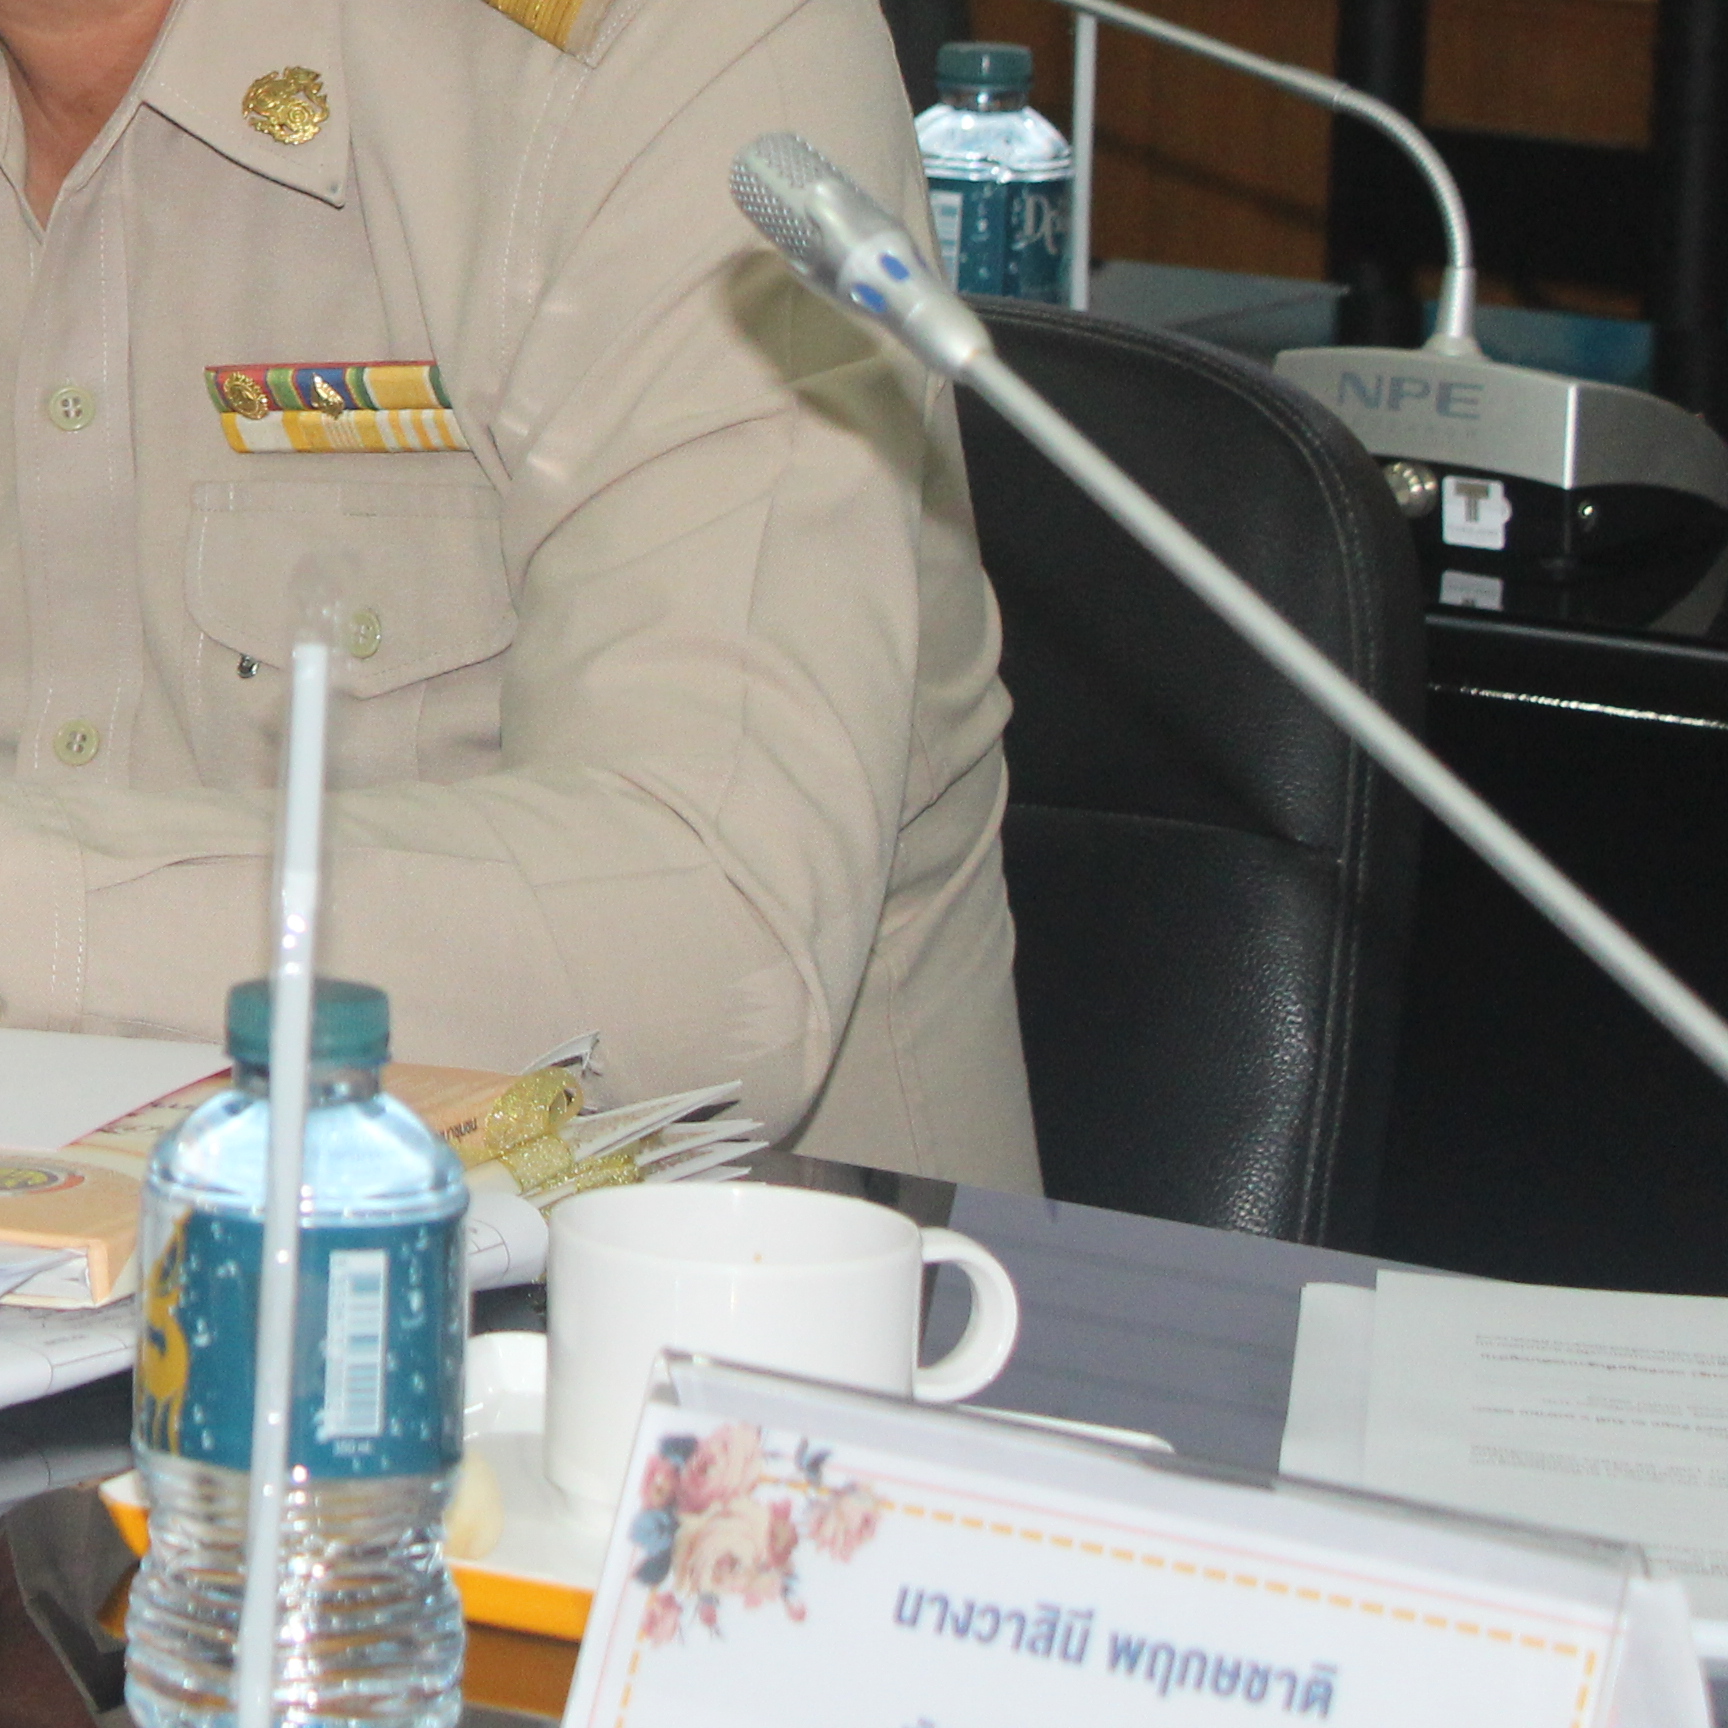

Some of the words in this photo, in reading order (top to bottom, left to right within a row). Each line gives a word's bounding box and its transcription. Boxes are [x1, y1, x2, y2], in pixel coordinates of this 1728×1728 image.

[1337, 372, 1486, 420] NPE
[891, 1582, 1095, 1666] นางวาสินี
